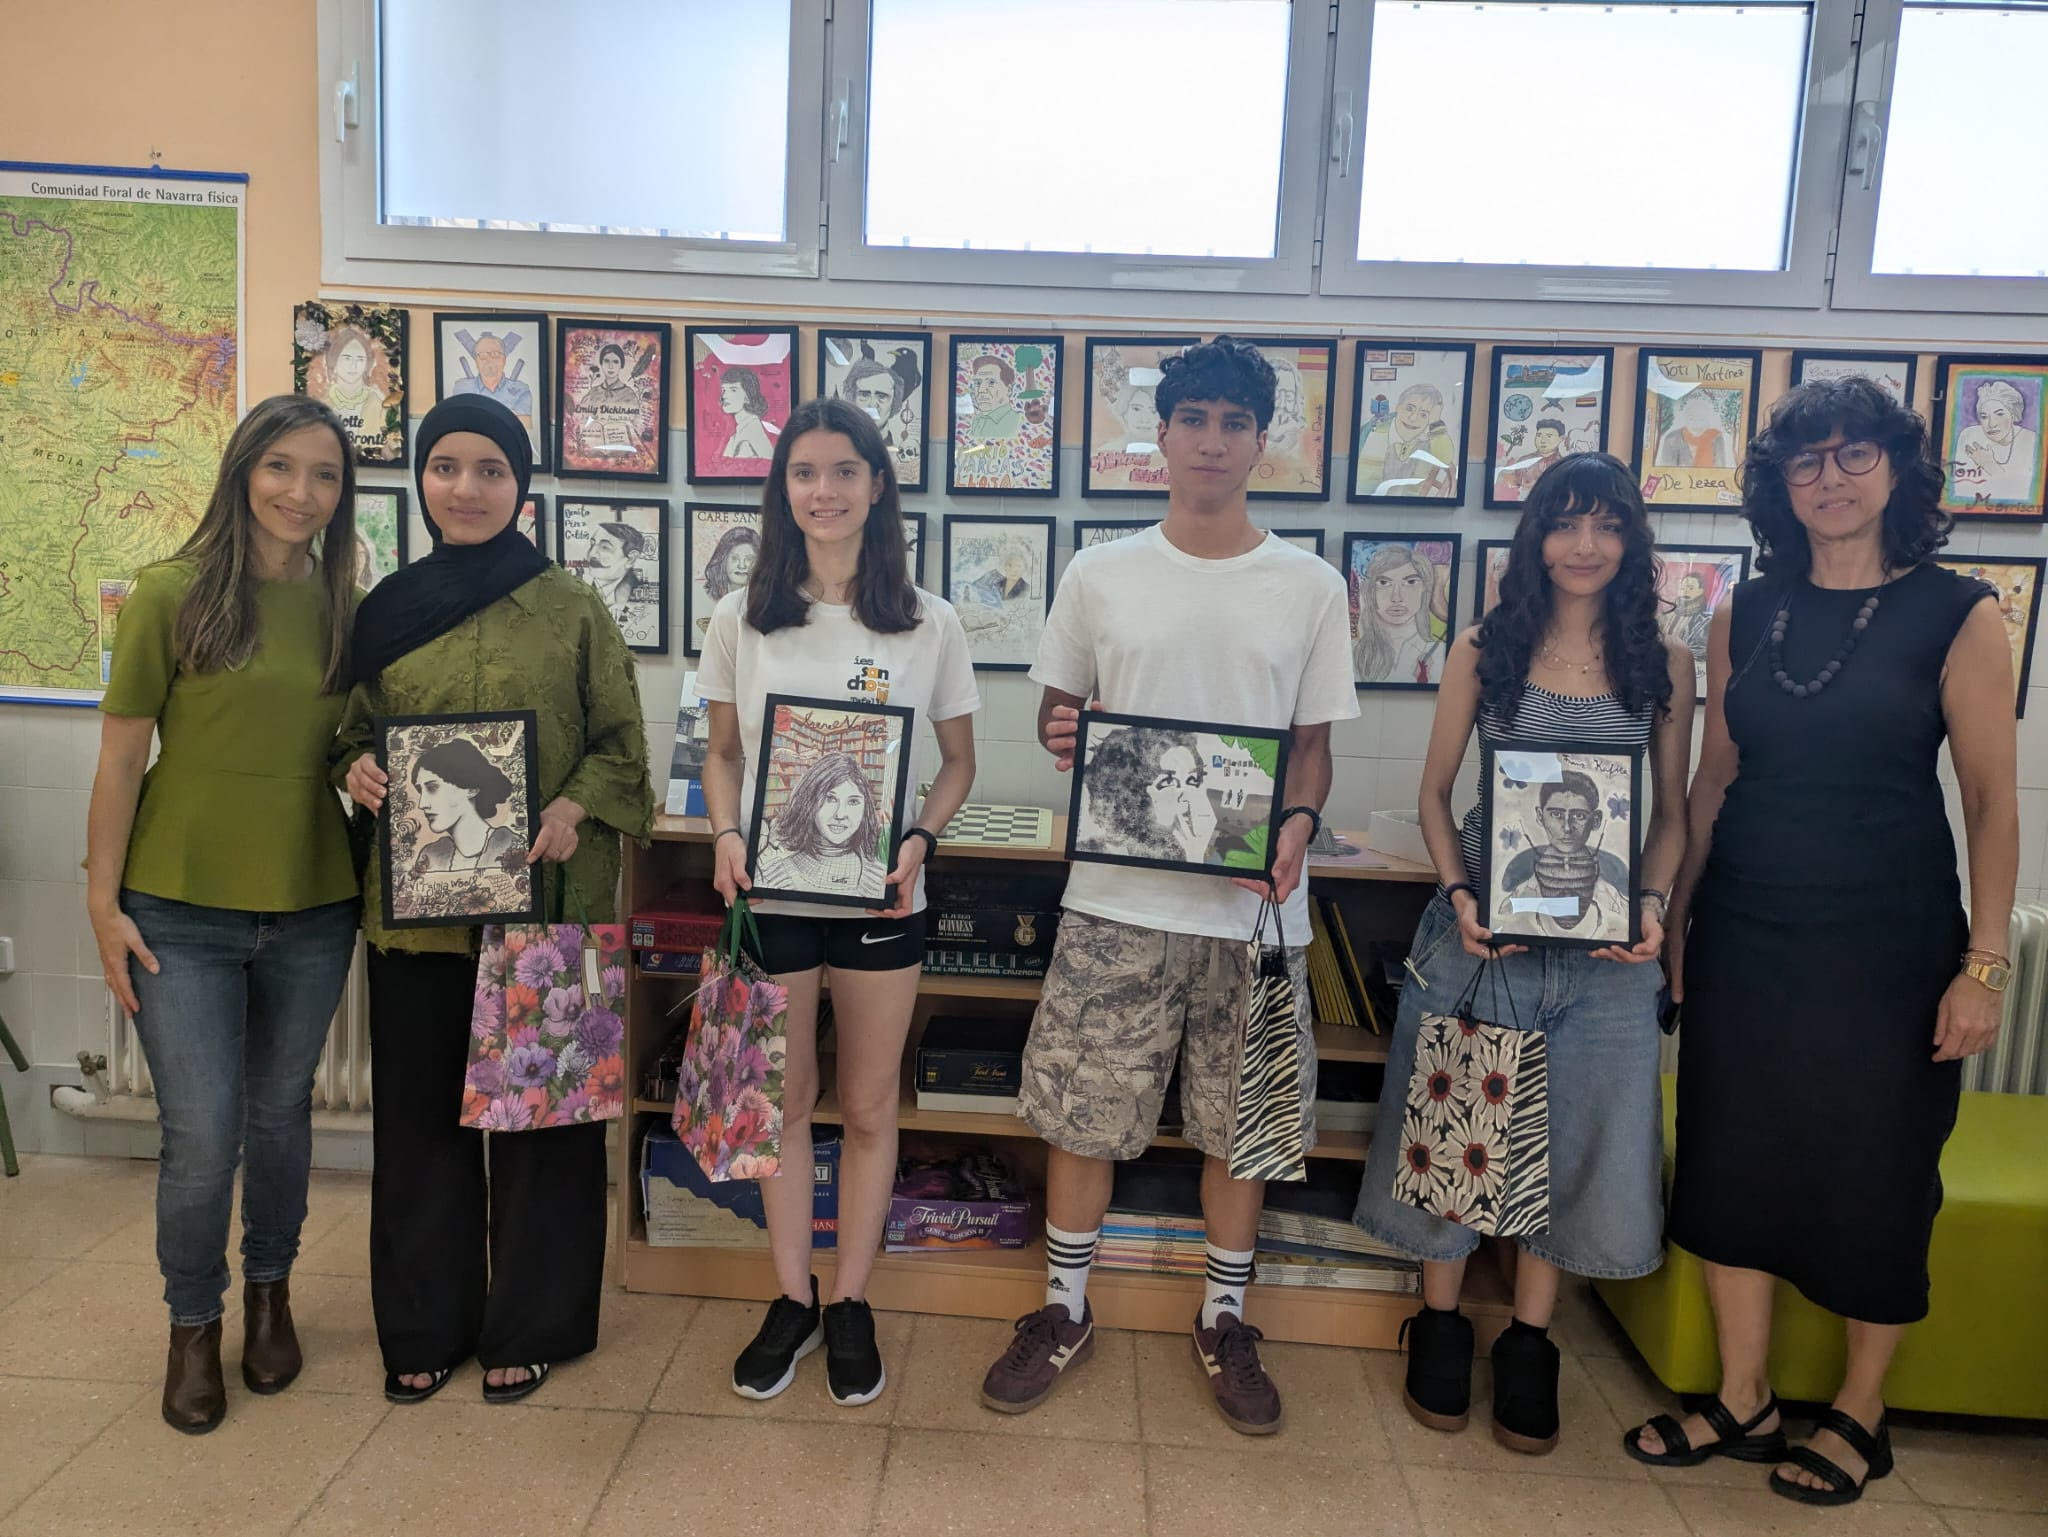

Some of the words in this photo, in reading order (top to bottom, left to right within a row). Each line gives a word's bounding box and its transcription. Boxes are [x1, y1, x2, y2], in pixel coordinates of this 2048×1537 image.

[31, 182, 98, 197] Comunidad
[103, 186, 132, 199] Foral
[137, 187, 151, 199] de
[156, 189, 203, 202] Navarra
[208, 191, 238, 204] física
[1660, 361, 1689, 377] Toti
[575, 404, 598, 416] Emily
[600, 404, 640, 415] Dickinson
[343, 415, 364, 428] otte
[32, 447, 84, 467] MEDIA
[1946, 461, 1983, 478] Toni
[1664, 474, 1683, 491] De
[1689, 475, 1728, 490] Lezea
[697, 511, 729, 523] CARE
[733, 511, 758, 523] SAN
[853, 656, 874, 665] ies
[805, 711, 839, 730] Irene
[938, 919, 974, 933] GUINNESS
[924, 949, 1018, 969] TELECT
[960, 967, 1001, 975] PALABRAS
[910, 1206, 954, 1225] Trivial
[949, 1206, 1000, 1230] Pursuit
